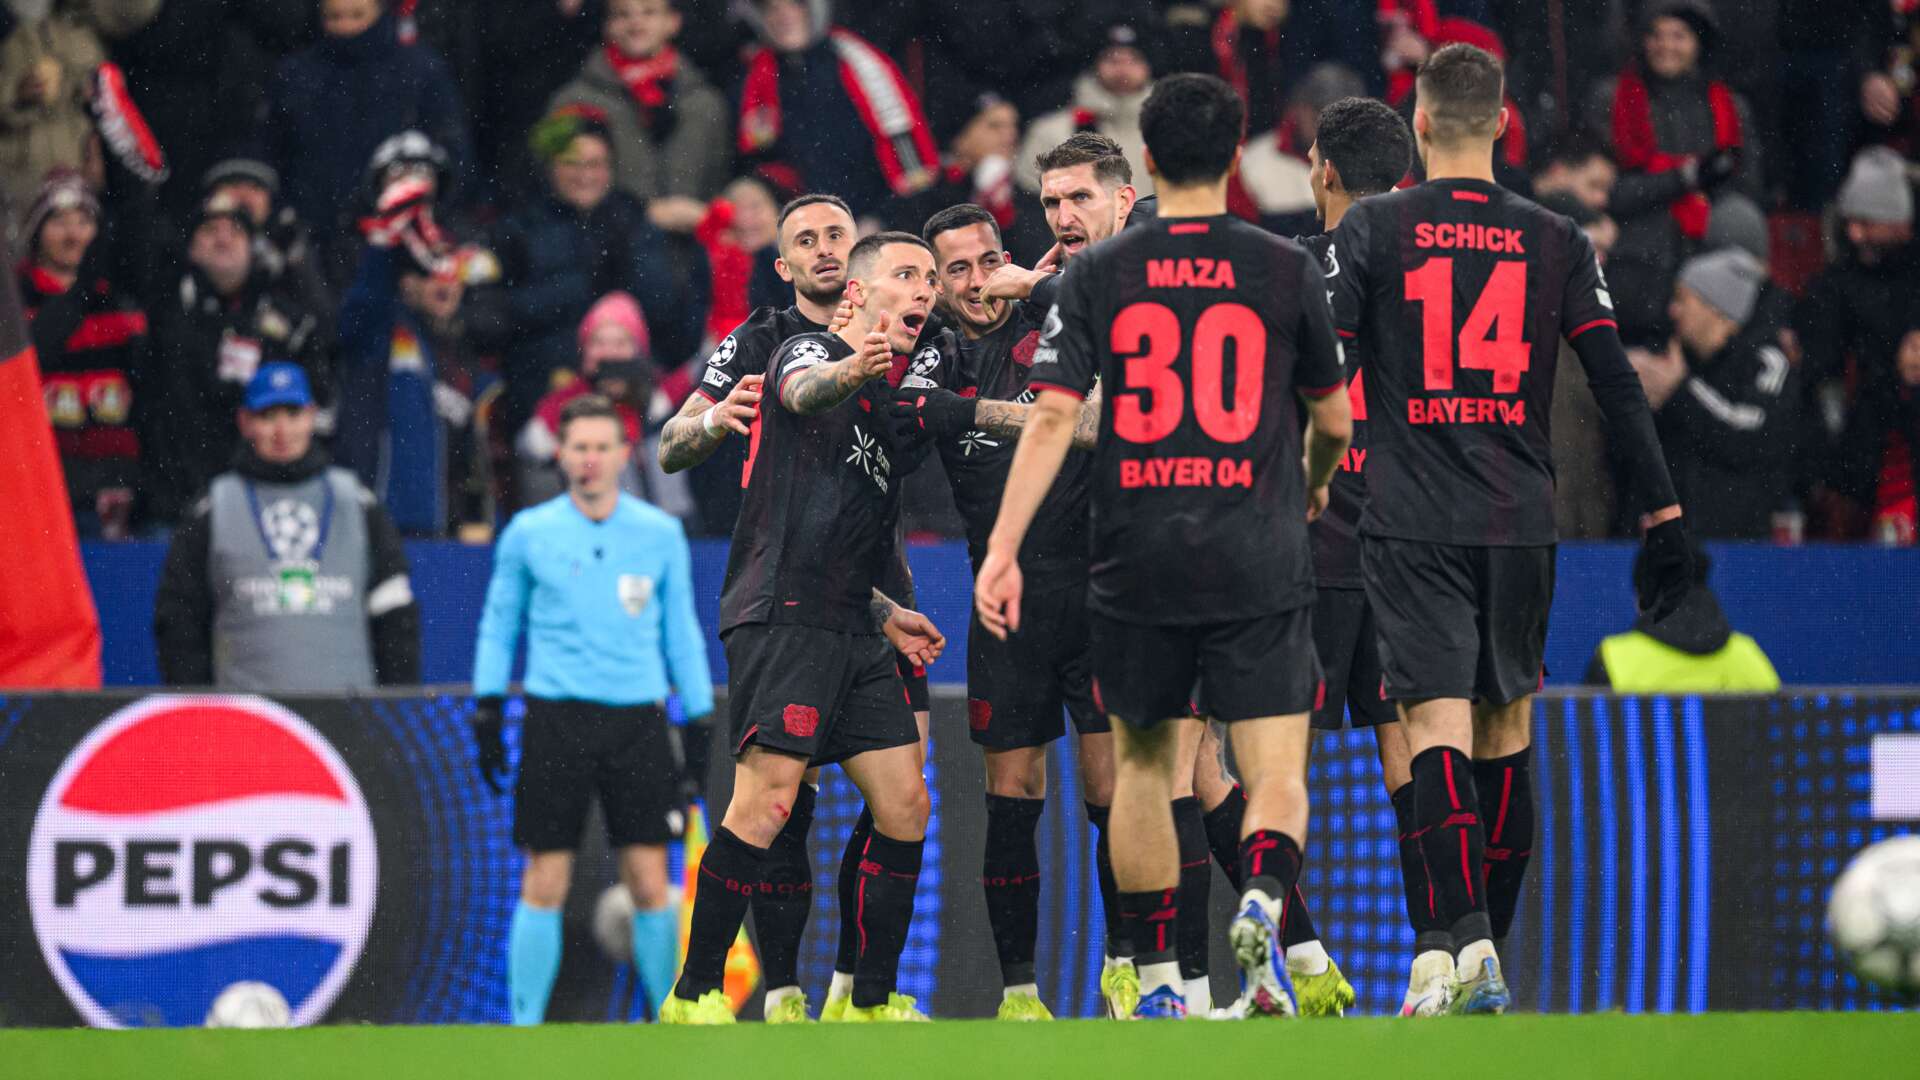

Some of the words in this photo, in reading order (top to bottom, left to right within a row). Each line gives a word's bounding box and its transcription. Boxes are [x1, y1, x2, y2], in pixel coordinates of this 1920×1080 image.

[1414, 222, 1525, 254] SCHICK
[1146, 257, 1236, 289] MAZA
[1404, 256, 1532, 394] 14
[1110, 301, 1267, 444] 30
[1407, 397, 1497, 424] BAYER
[1497, 400, 1526, 426] 04
[1120, 457, 1214, 488] BAYER
[1216, 457, 1253, 488] 04
[53, 840, 351, 908] PEPSI
